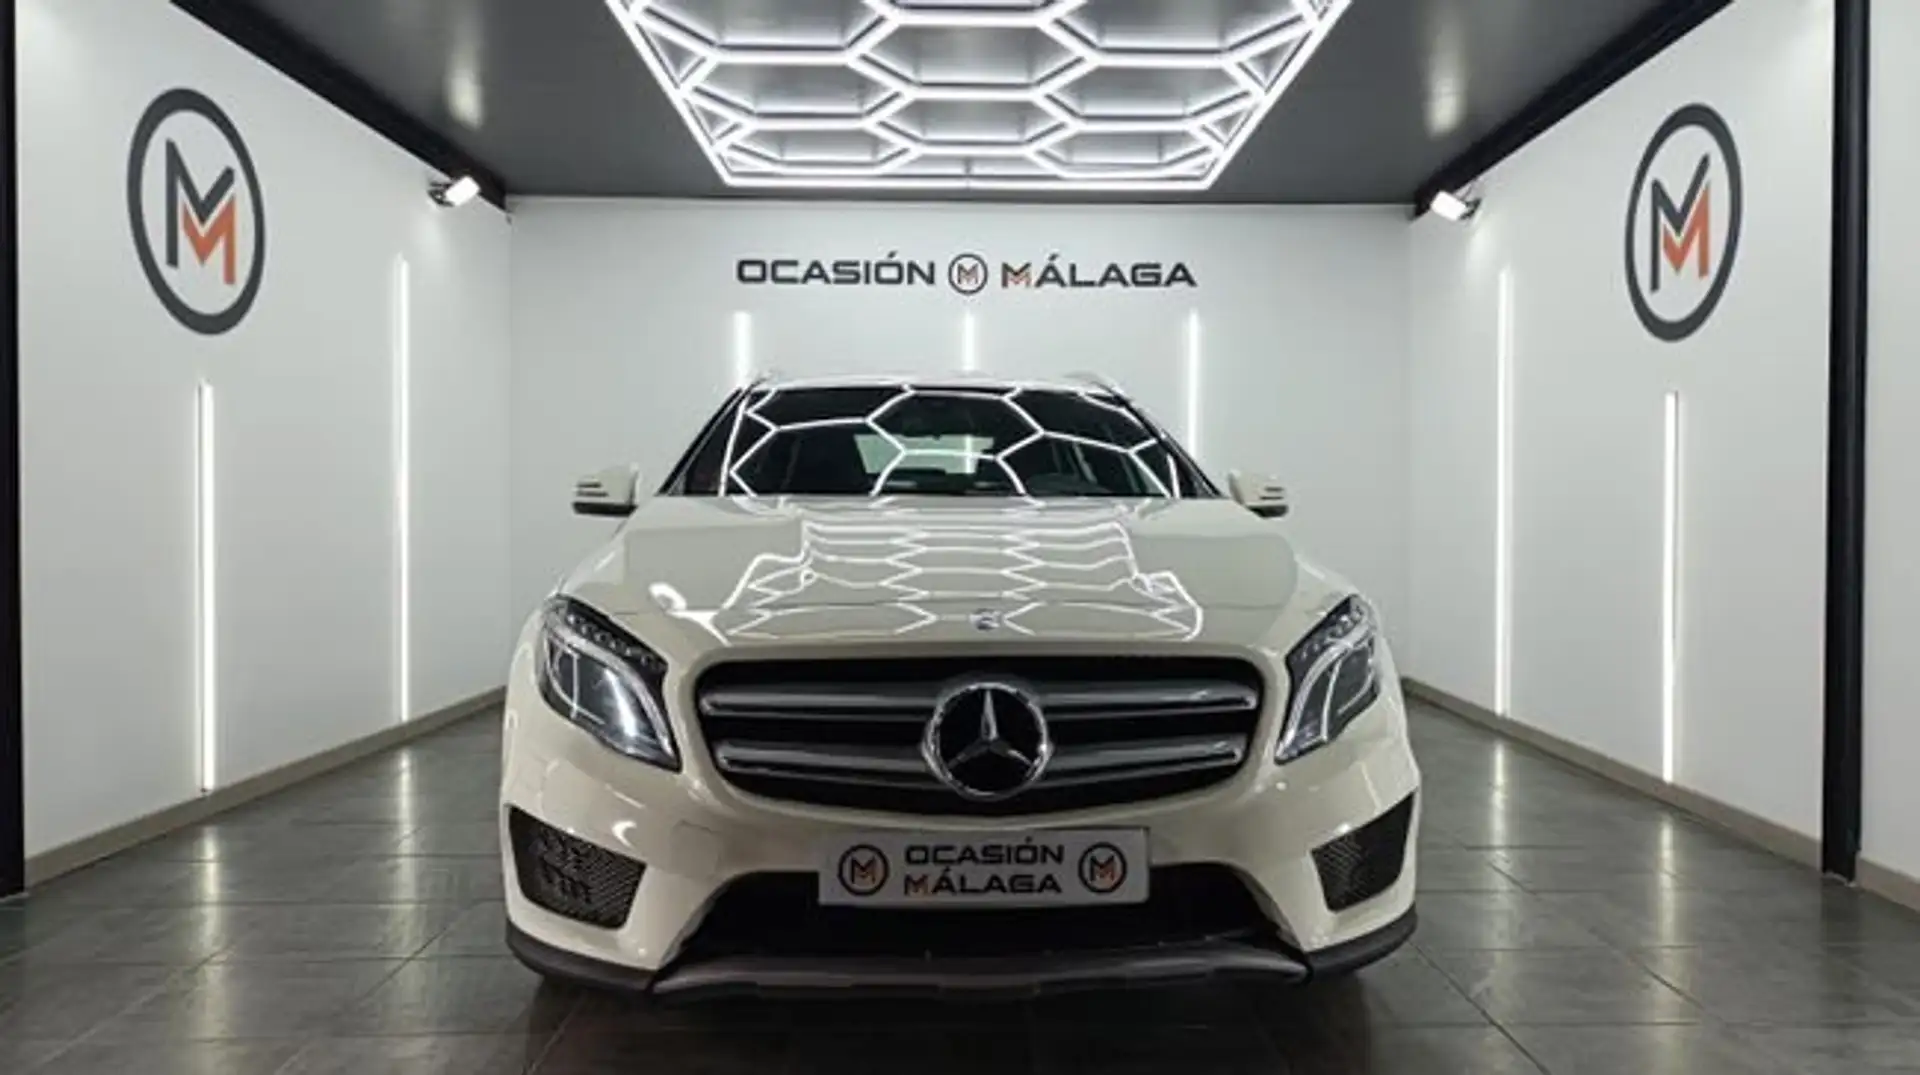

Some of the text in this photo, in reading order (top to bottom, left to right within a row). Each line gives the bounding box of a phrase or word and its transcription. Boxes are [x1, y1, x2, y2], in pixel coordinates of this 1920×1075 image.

[736, 251, 935, 286] OCASIÓN
[1000, 254, 1198, 288] MÁLAGA
[904, 836, 1065, 866] OCASIÓN
[904, 866, 1063, 896] MÁLAGA
